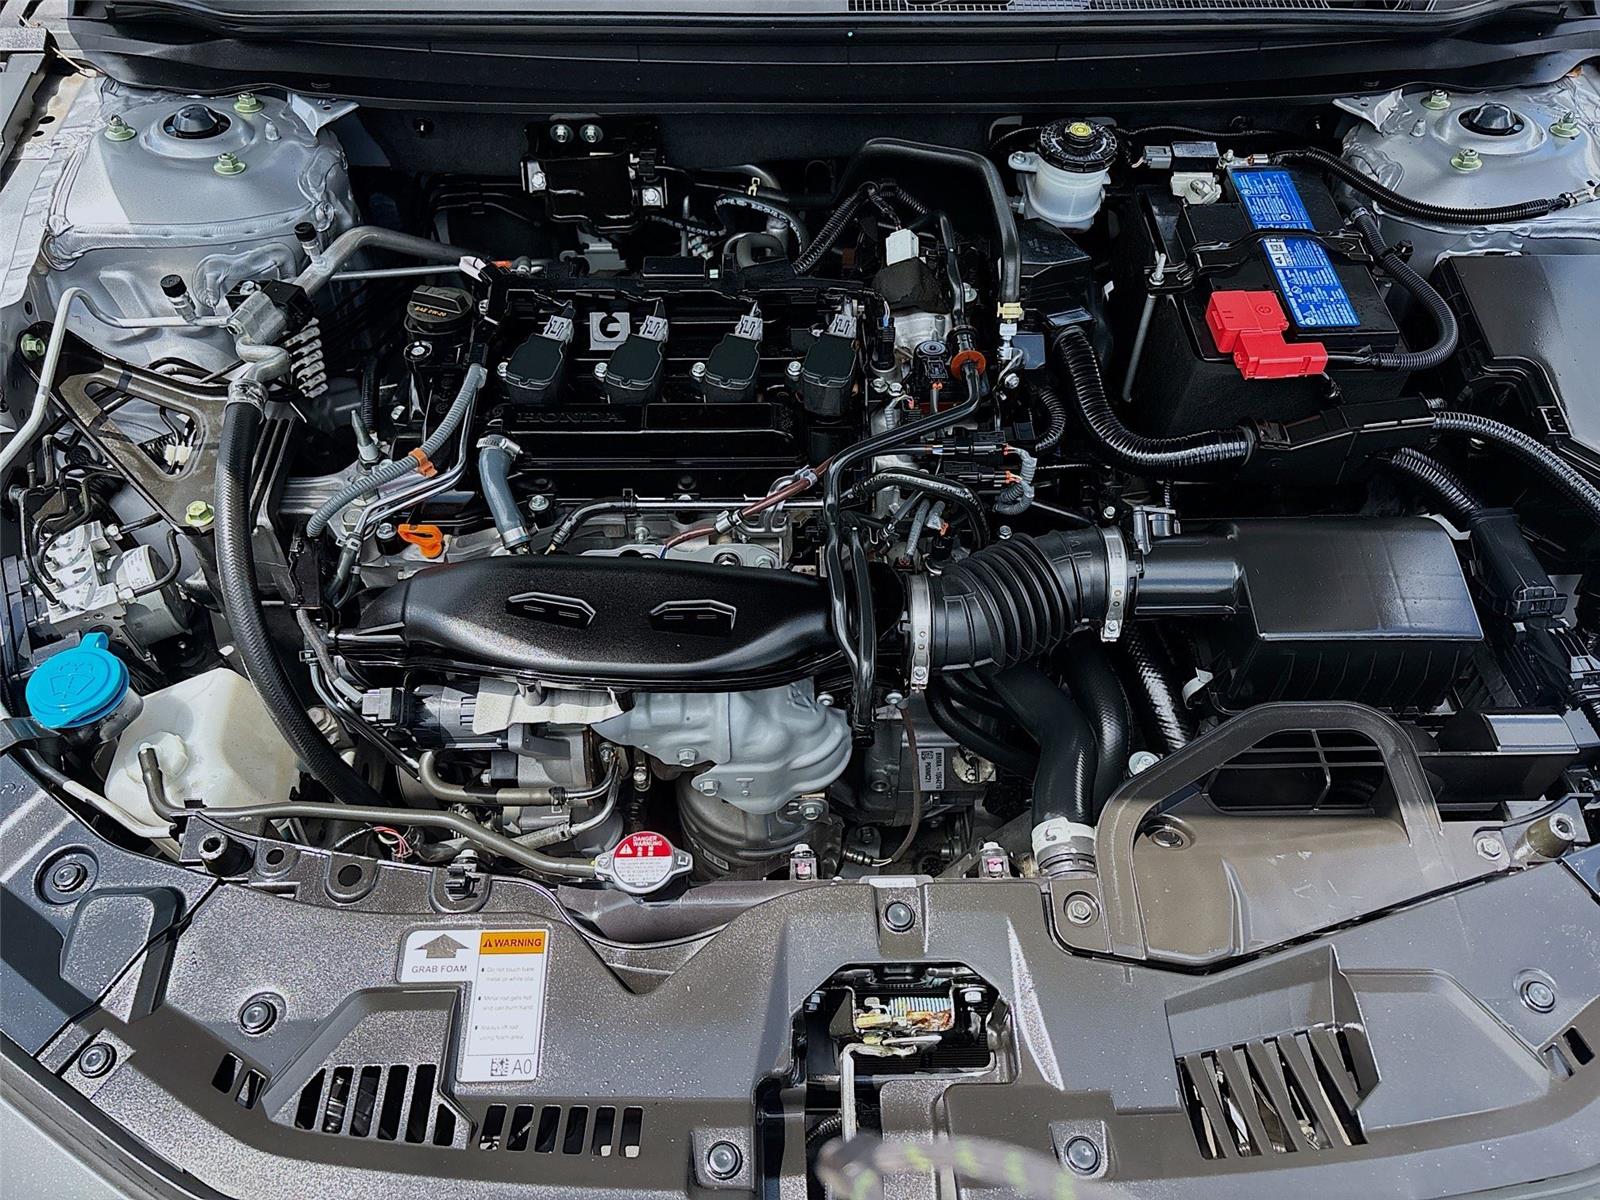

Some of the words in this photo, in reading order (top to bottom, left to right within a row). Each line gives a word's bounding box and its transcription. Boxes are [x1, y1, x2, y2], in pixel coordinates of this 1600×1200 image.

[516, 412, 627, 423] HONDA
[494, 938, 542, 948] WARNING
[411, 965, 438, 974] GRAB
[440, 964, 468, 973] FOAM
[511, 1058, 532, 1075] A0
